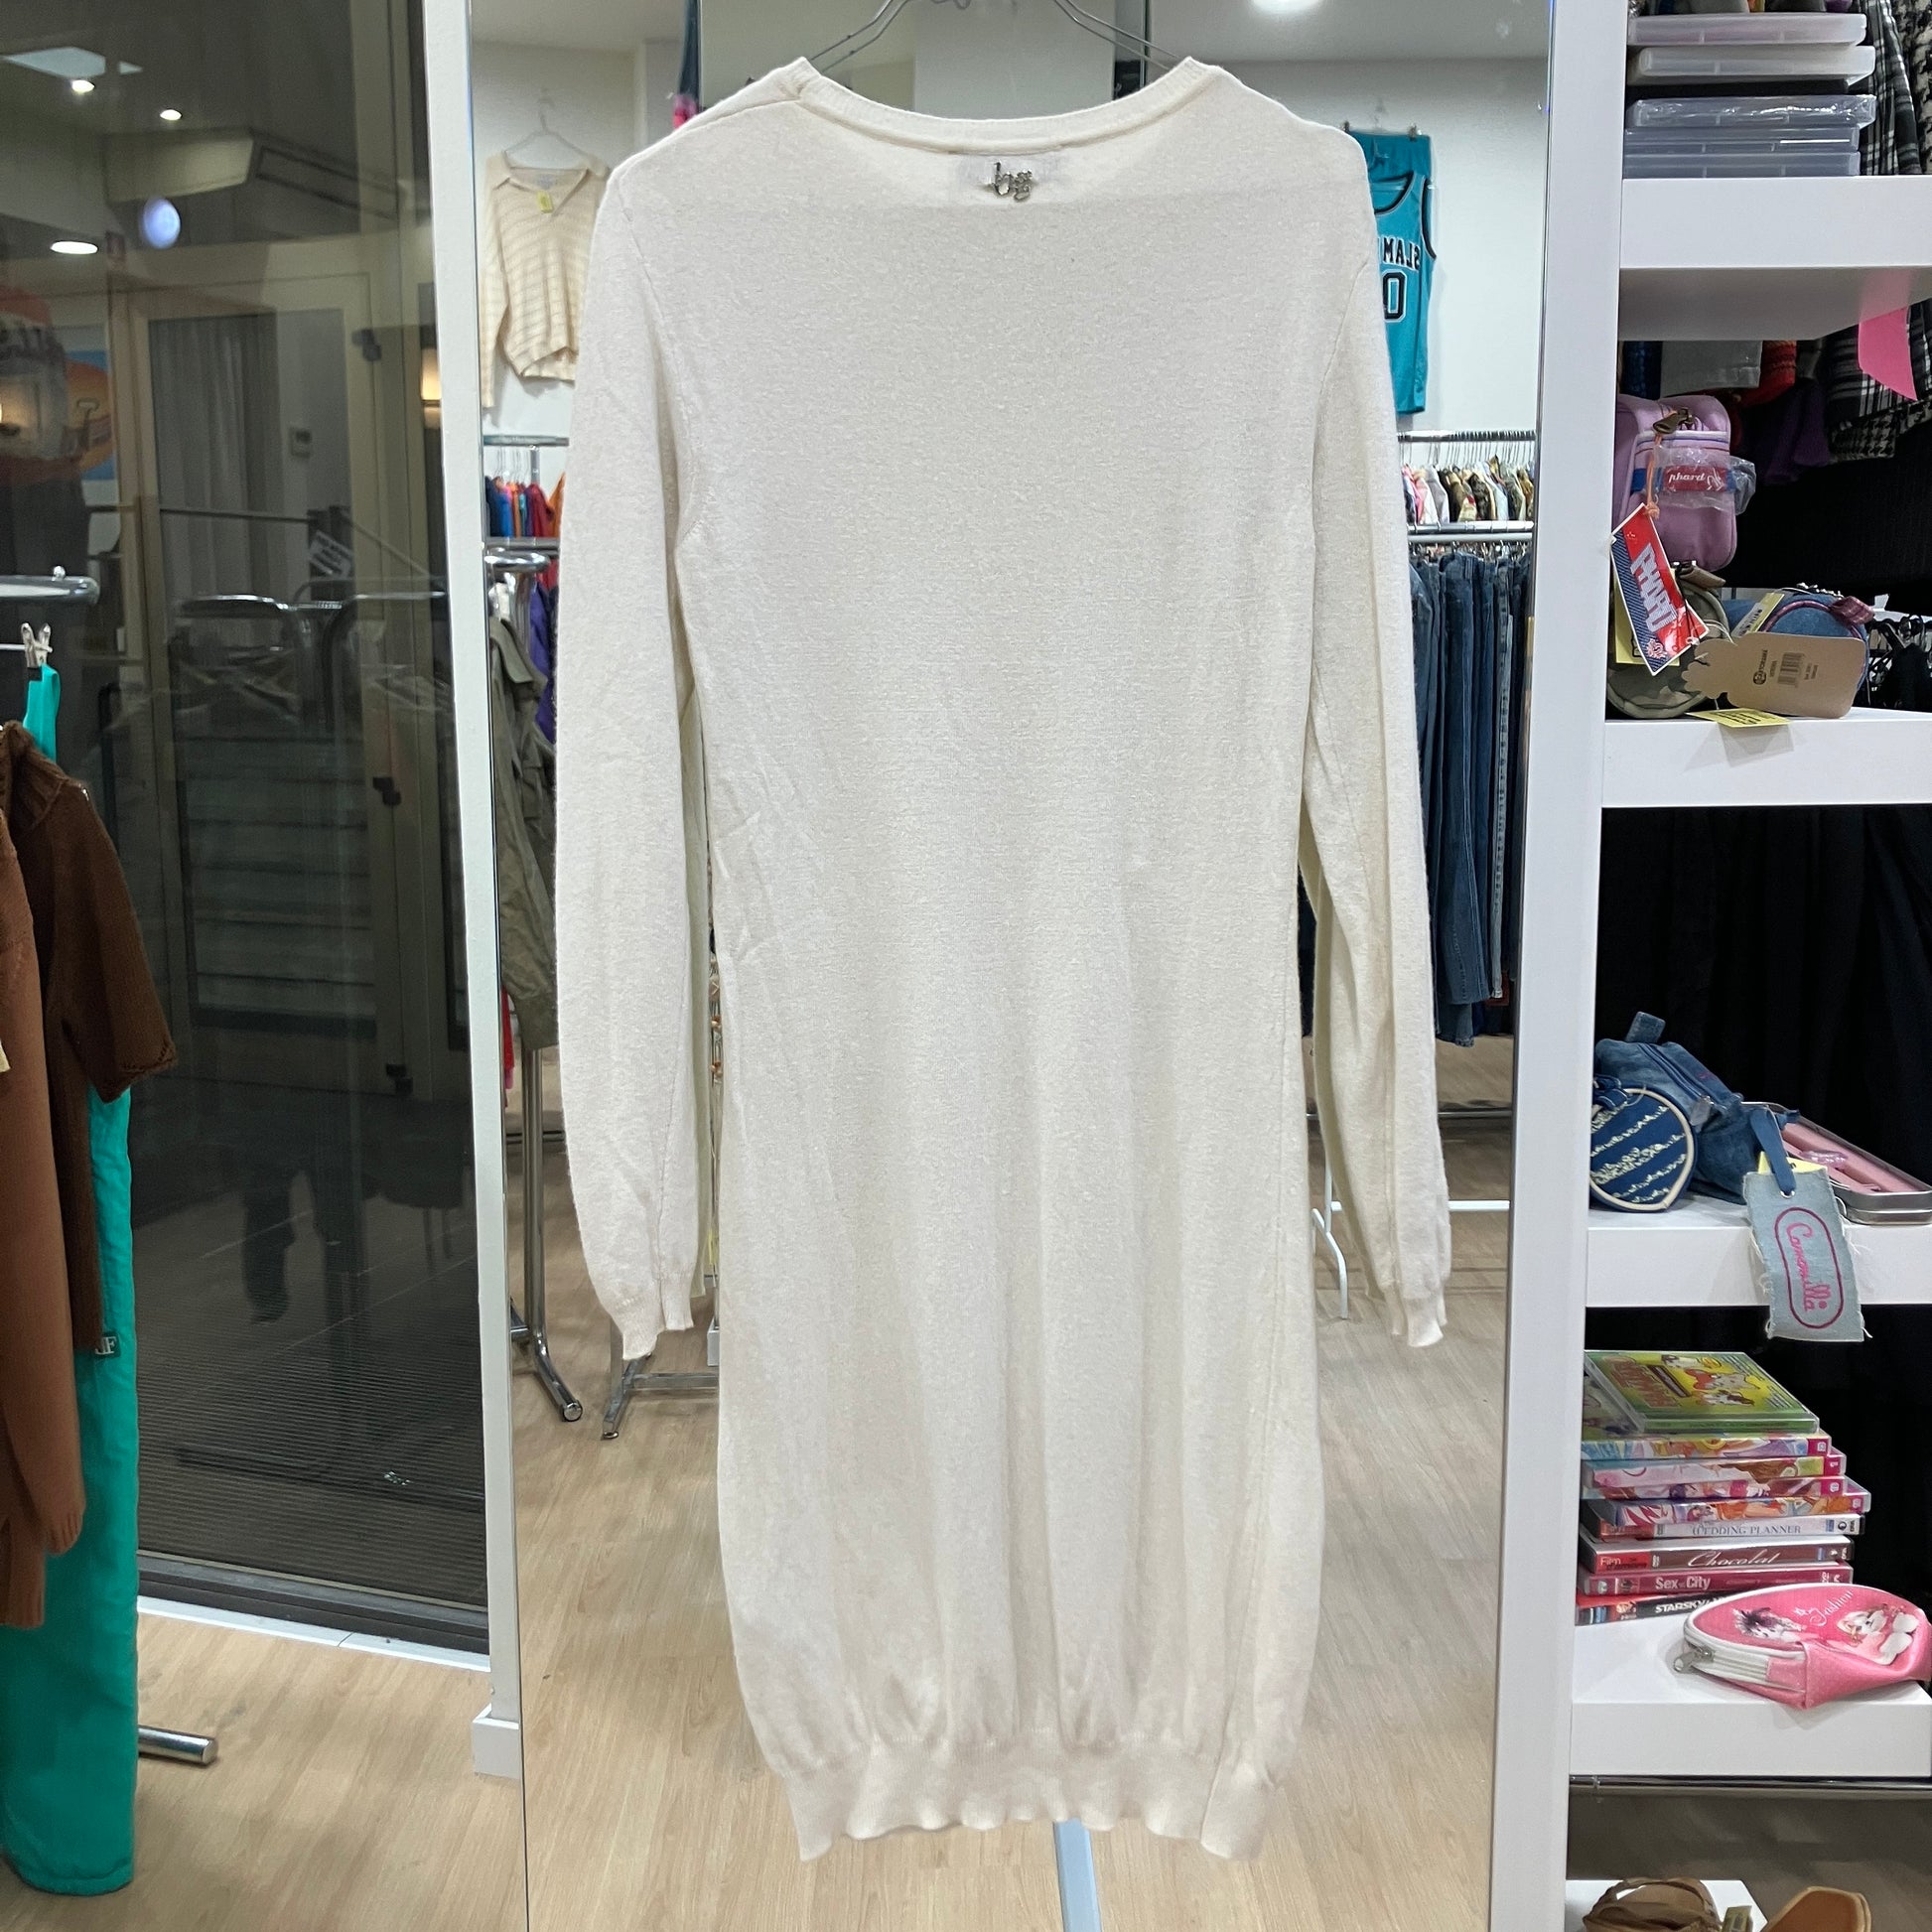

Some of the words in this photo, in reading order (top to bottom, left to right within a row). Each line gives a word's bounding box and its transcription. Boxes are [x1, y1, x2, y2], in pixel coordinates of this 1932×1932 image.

[1750, 1525, 1801, 1535] PLANNER
[1688, 1549, 1781, 1568] Chocolat
[1655, 1576, 1679, 1589] Sex
[1686, 1575, 1711, 1590] City
